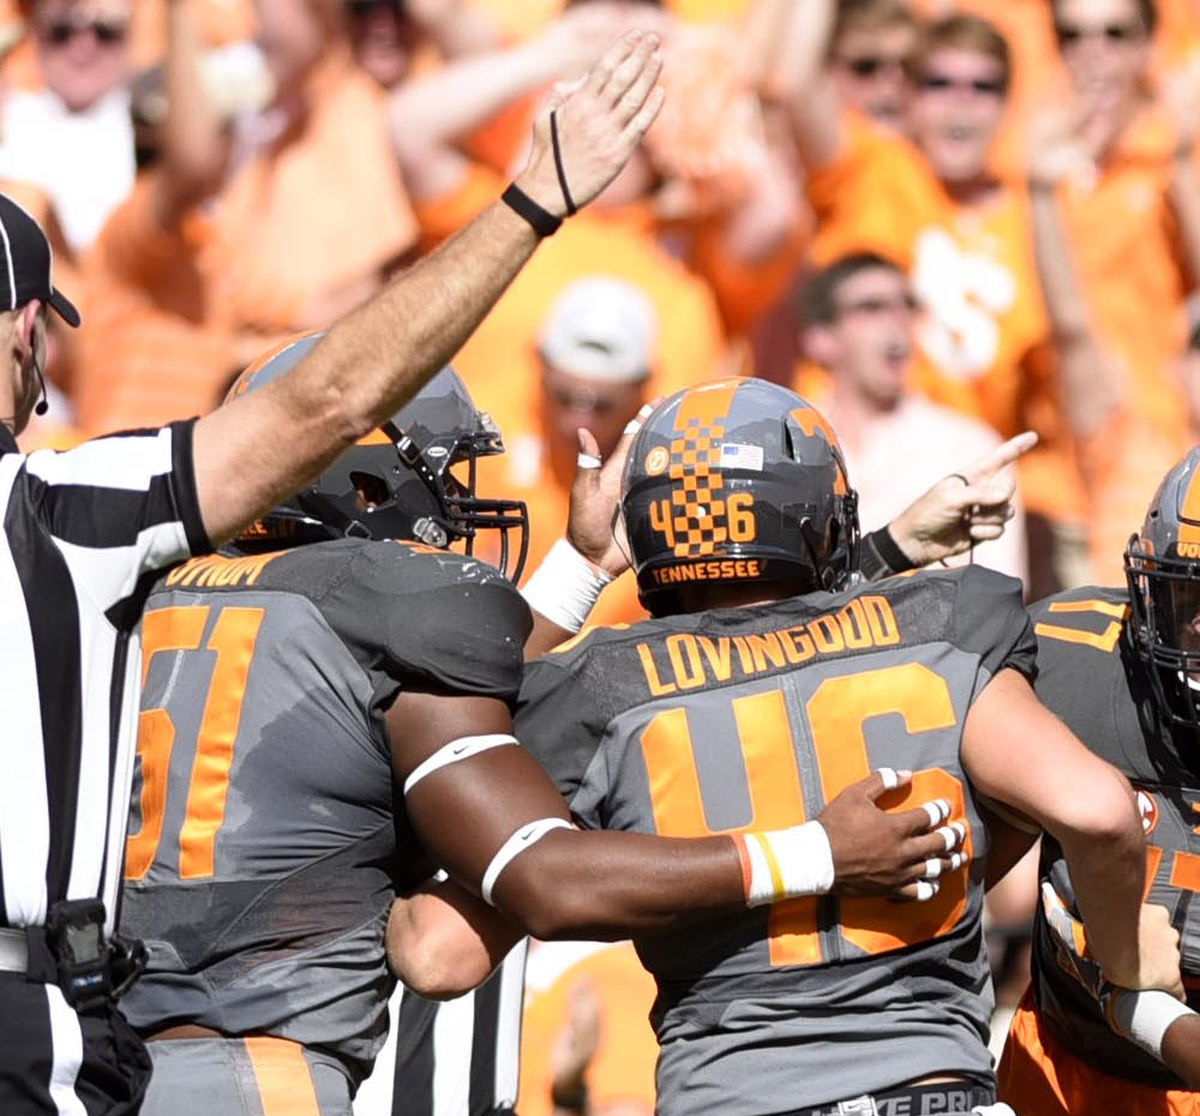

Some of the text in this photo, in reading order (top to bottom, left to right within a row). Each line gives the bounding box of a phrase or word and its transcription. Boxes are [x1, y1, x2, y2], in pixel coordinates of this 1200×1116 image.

[654, 559, 761, 584] TENNESSEE
[636, 595, 901, 697] LOVINGOOD
[640, 661, 957, 968] 46
